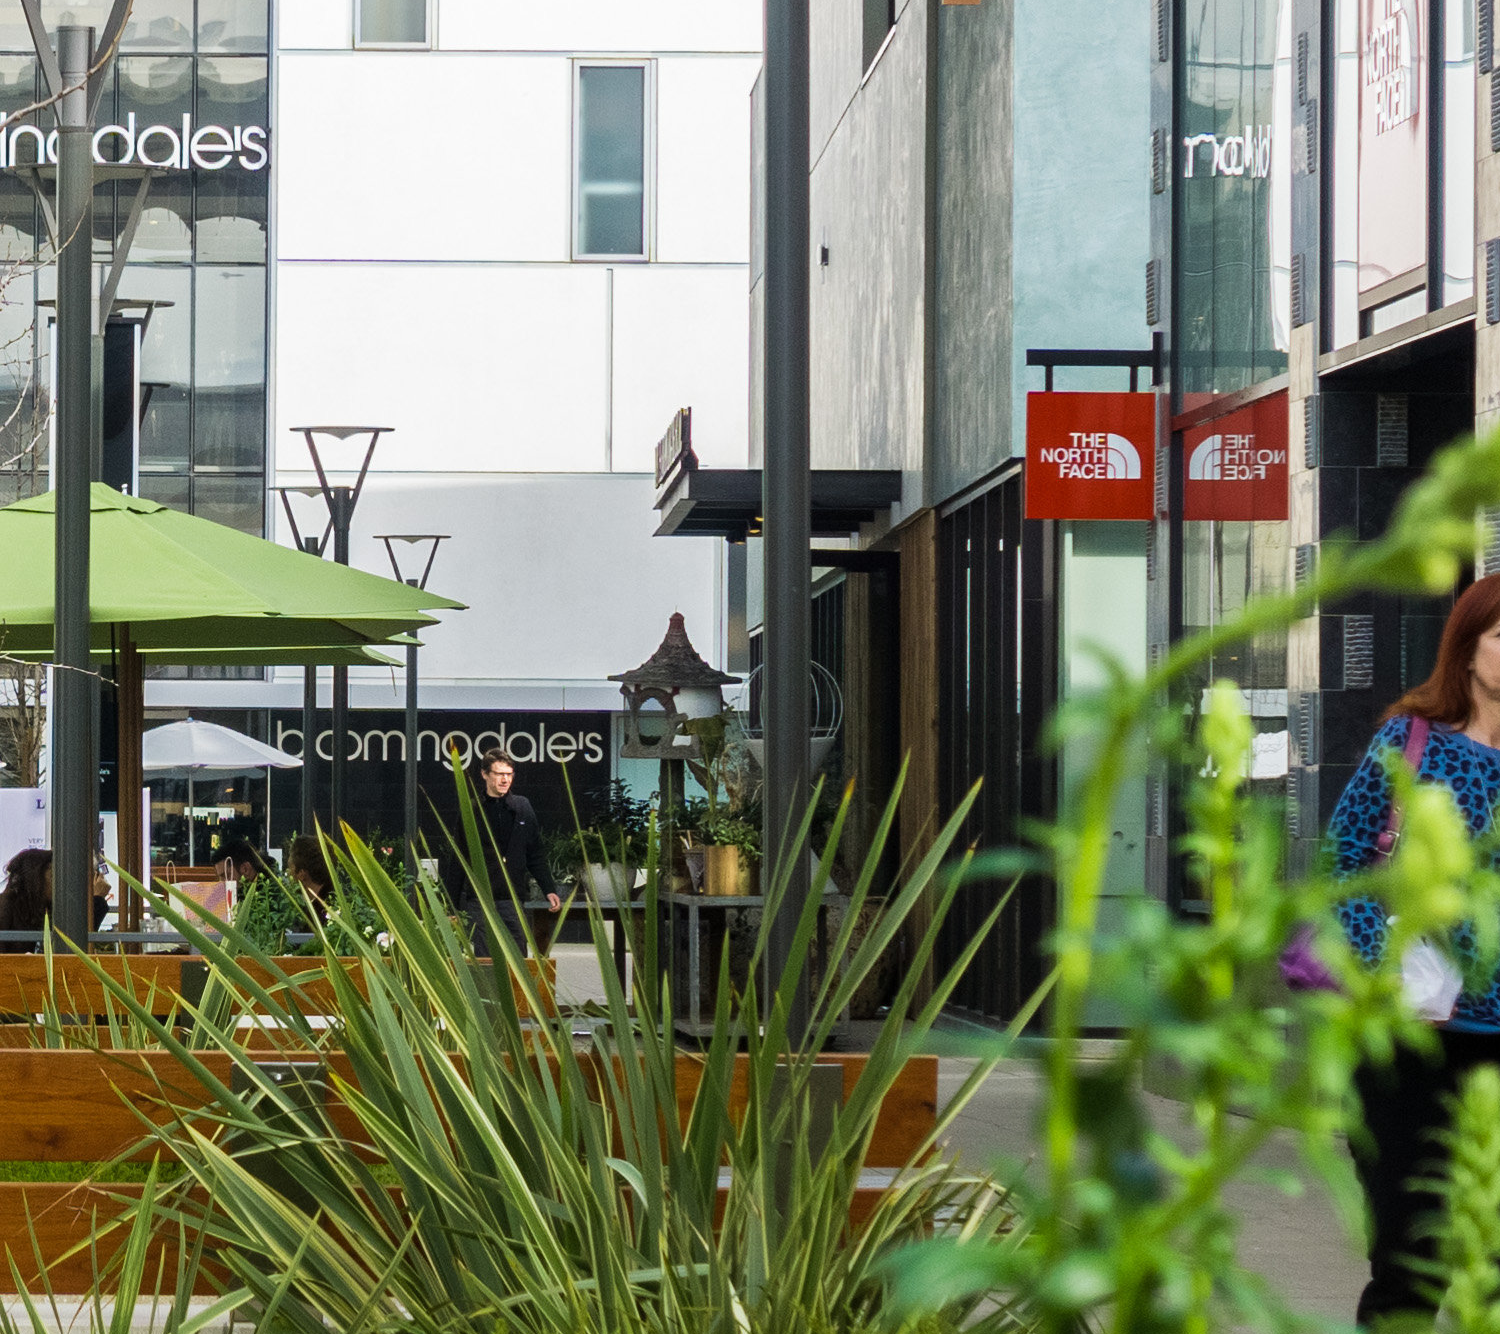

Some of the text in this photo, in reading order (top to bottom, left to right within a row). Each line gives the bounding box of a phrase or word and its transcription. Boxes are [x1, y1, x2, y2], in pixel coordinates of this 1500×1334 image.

[1366, 17, 1400, 87] NORTH
[1375, 68, 1403, 137] FACE
[1040, 448, 1106, 463] NORTH
[1069, 433, 1106, 448] THE
[1059, 464, 1106, 479] FACE
[276, 719, 604, 771] boomngdale's
